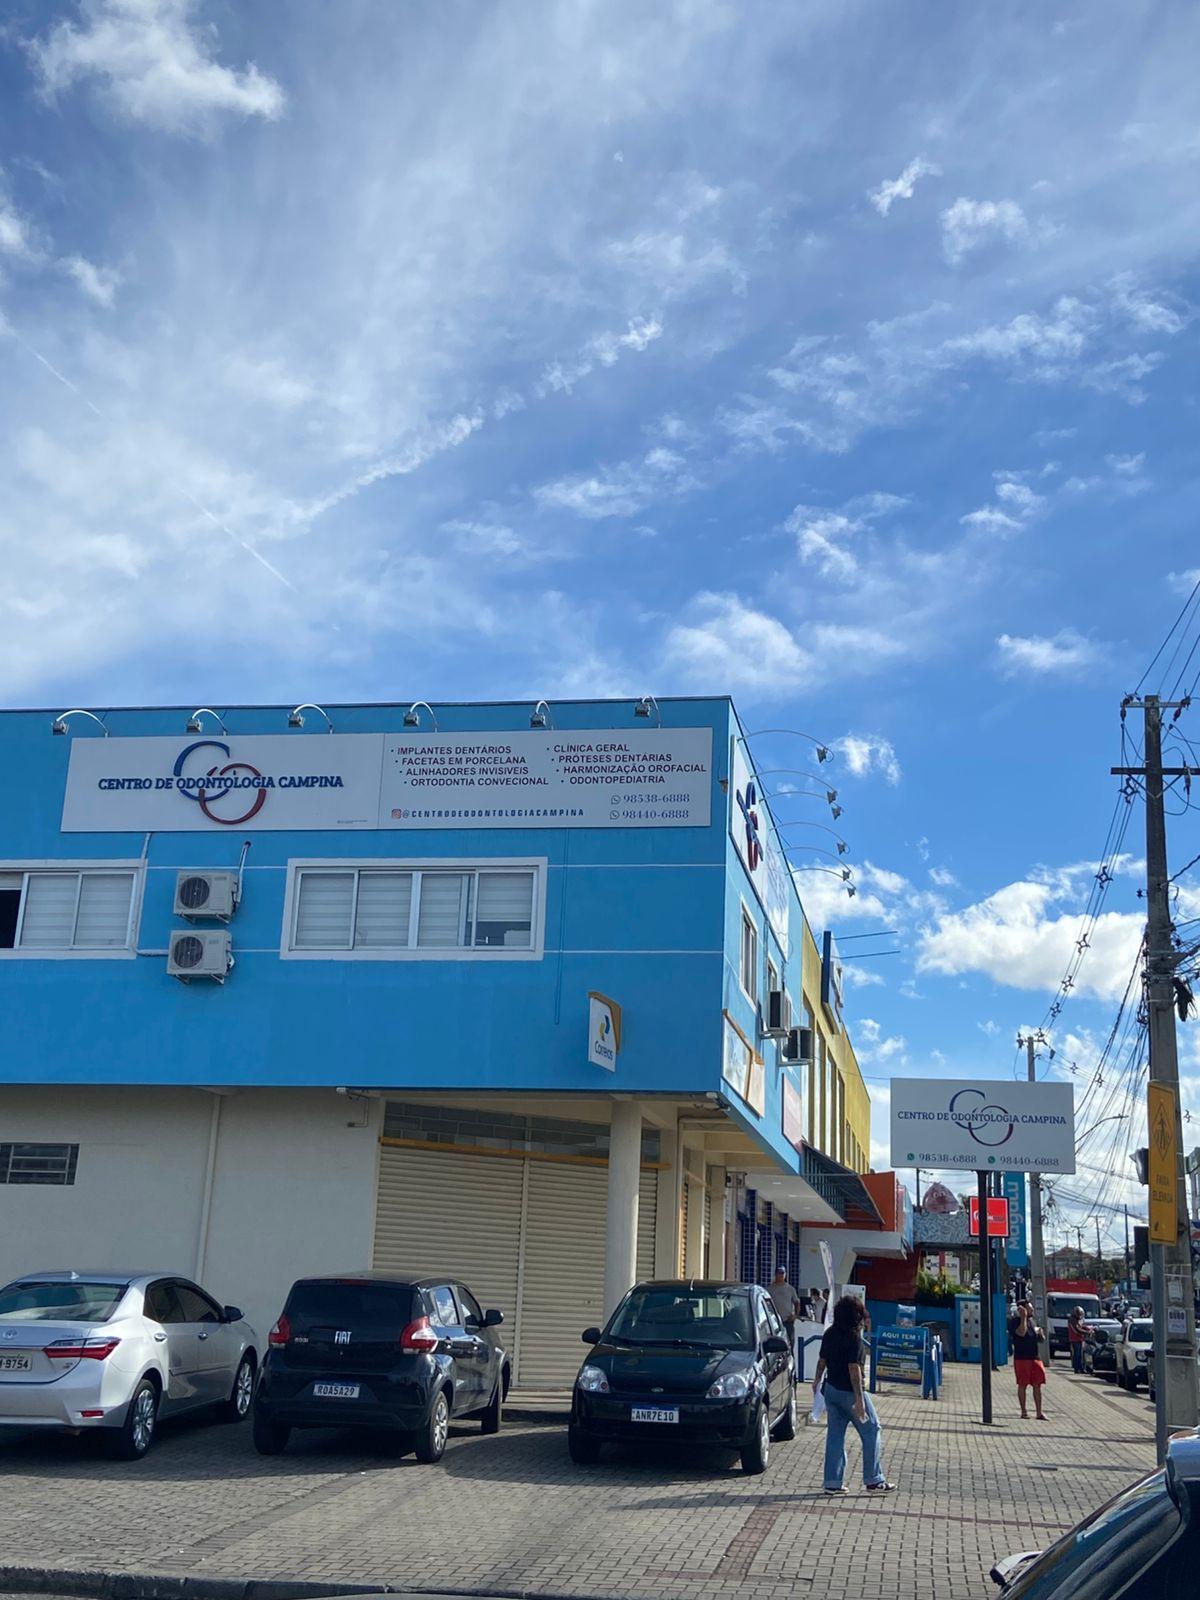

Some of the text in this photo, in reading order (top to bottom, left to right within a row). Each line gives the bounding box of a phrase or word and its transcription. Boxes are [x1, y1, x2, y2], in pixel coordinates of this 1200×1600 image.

[397, 744, 512, 755] IMPLANTES DENTÁRIOS
[554, 743, 630, 752] CLÍNICA GERAL
[466, 756, 526, 764] PORCELANA
[614, 752, 672, 762] DENTÁRIAS
[406, 768, 476, 776] ALINHADORES
[564, 764, 707, 775] HARMONIZAÇÃO OROFACIAL
[98, 776, 344, 790] CENTRO DE ODONTOLOGIA CAMPINA
[410, 778, 549, 786] ORTODONTIA CONVECIONAL
[570, 776, 666, 784] ODONTOPEDIATRIA
[624, 794, 690, 803] 98538-6888
[622, 810, 689, 820] 98440-6888
[898, 1111, 1066, 1124] CENTRO DE ODONTOLOGIA CAMPINA
[918, 1152, 1059, 1166] 98538-6888 98440-6888
[334, 1331, 352, 1344] FIAT
